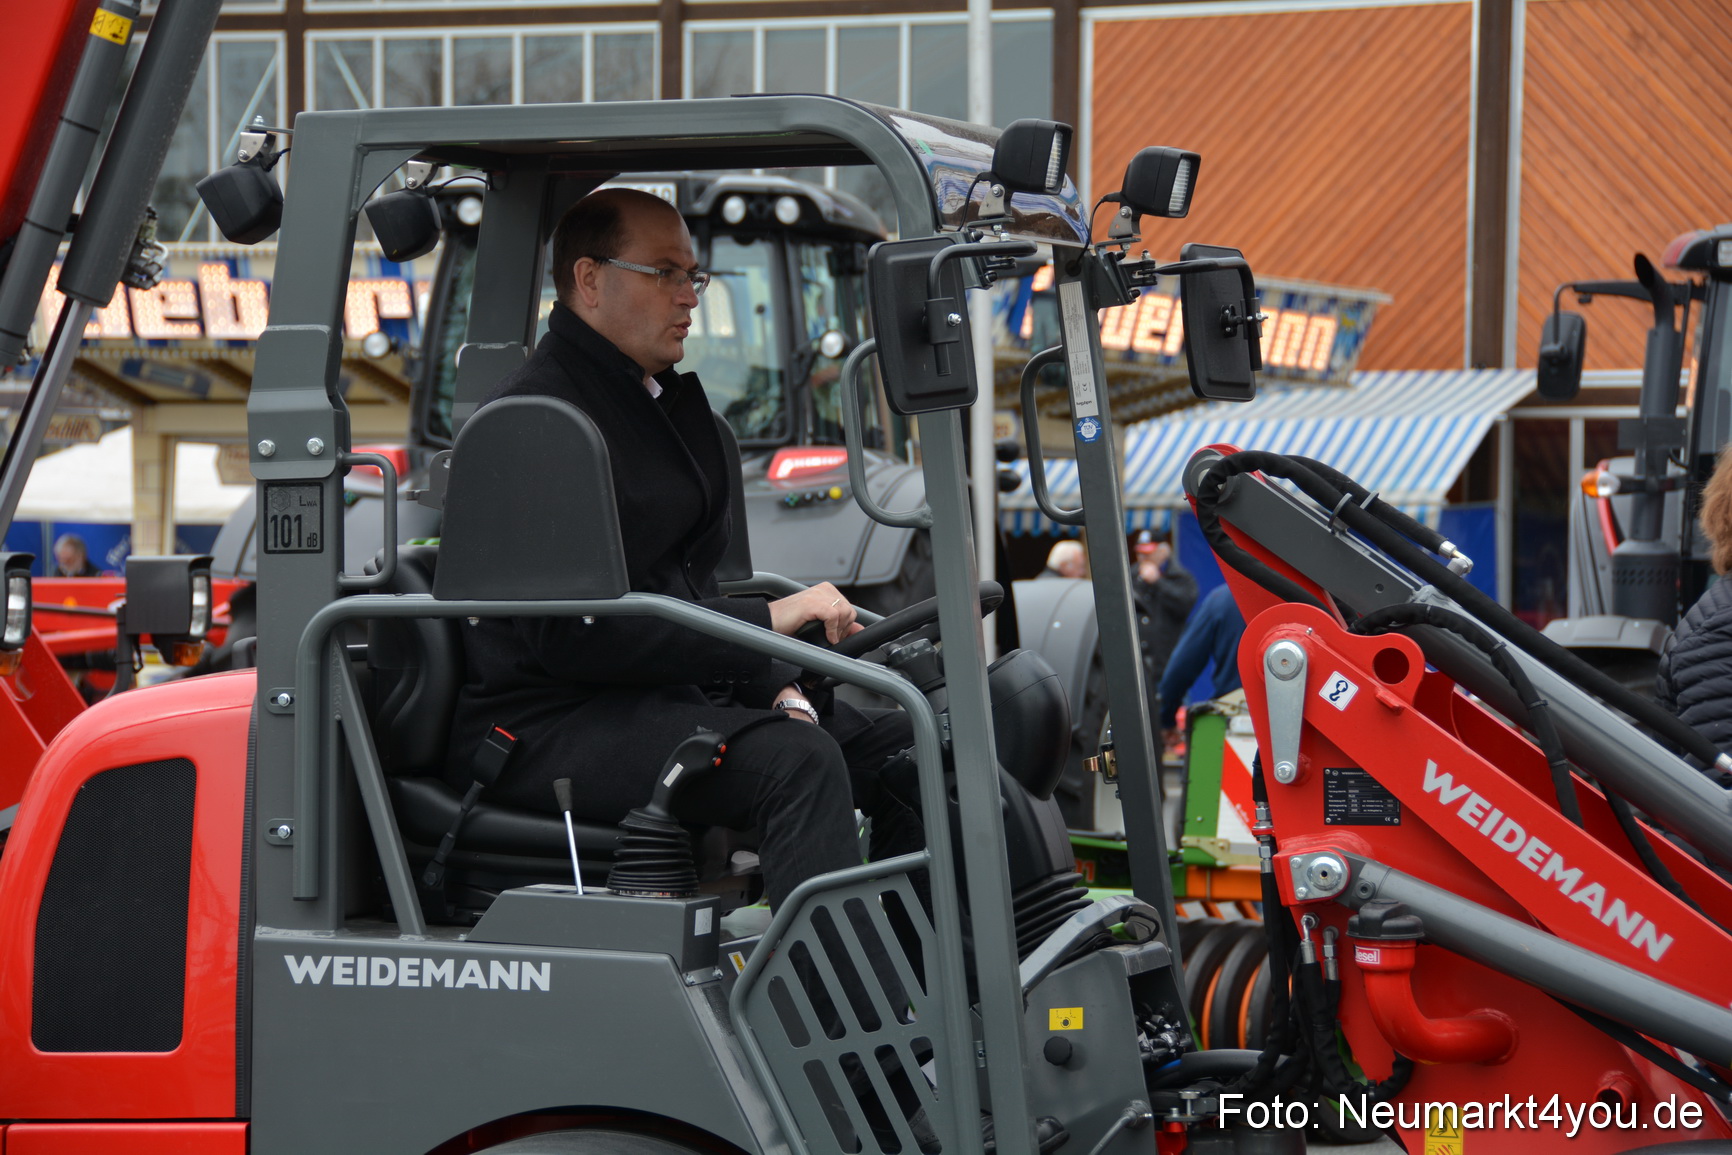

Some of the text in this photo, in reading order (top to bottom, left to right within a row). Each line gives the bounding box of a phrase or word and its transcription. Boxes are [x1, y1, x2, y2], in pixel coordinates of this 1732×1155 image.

[270, 514, 318, 548] 101 dB
[1422, 758, 1674, 962] WEIDEMANN
[284, 955, 551, 992] WEIDEMANN
